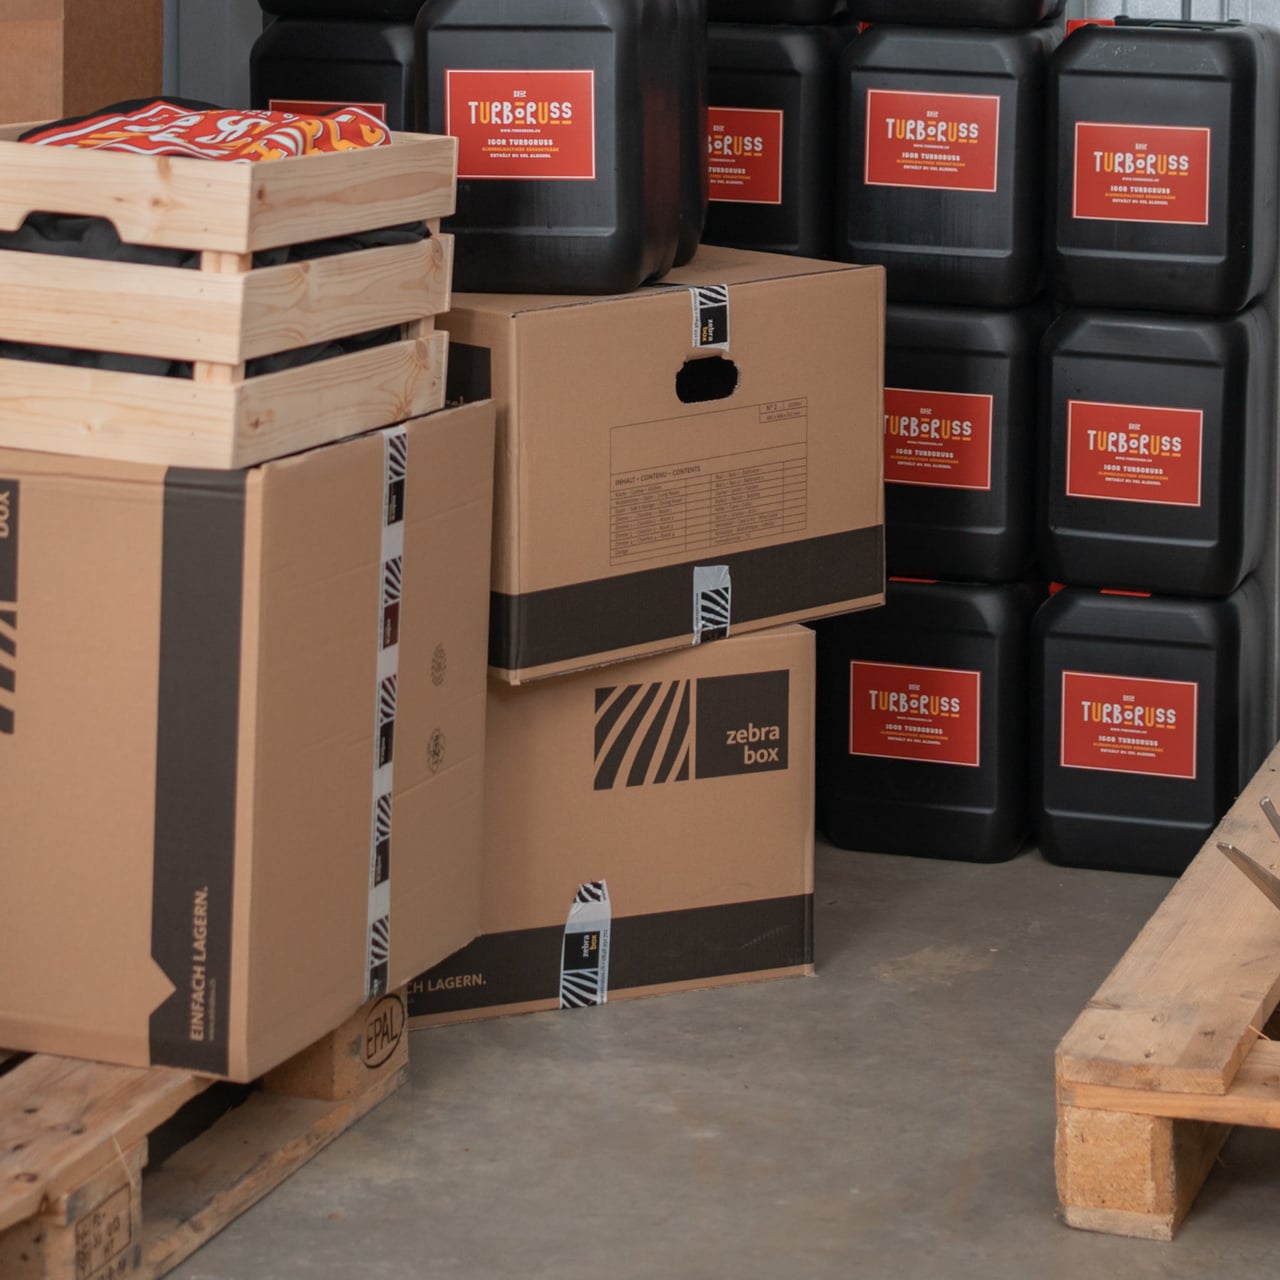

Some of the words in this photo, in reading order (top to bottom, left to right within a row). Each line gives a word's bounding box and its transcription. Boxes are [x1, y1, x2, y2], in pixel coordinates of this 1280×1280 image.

[468, 101, 572, 124] TURBORUSS
[885, 117, 978, 143] TURBORUSS
[1093, 151, 1188, 176] TURBORUSS
[1087, 429, 1181, 457] TURBORUSS
[869, 689, 959, 718] TURBORUSS
[1081, 700, 1176, 729] TURBORUSS
[726, 723, 780, 745] zebra
[744, 745, 779, 765] box
[193, 885, 209, 961] LAGERN.
[581, 934, 590, 958] zebra
[427, 973, 487, 992] LAGERN.
[190, 965, 206, 1041] EINFACH
[366, 1006, 398, 1060] EPAL
